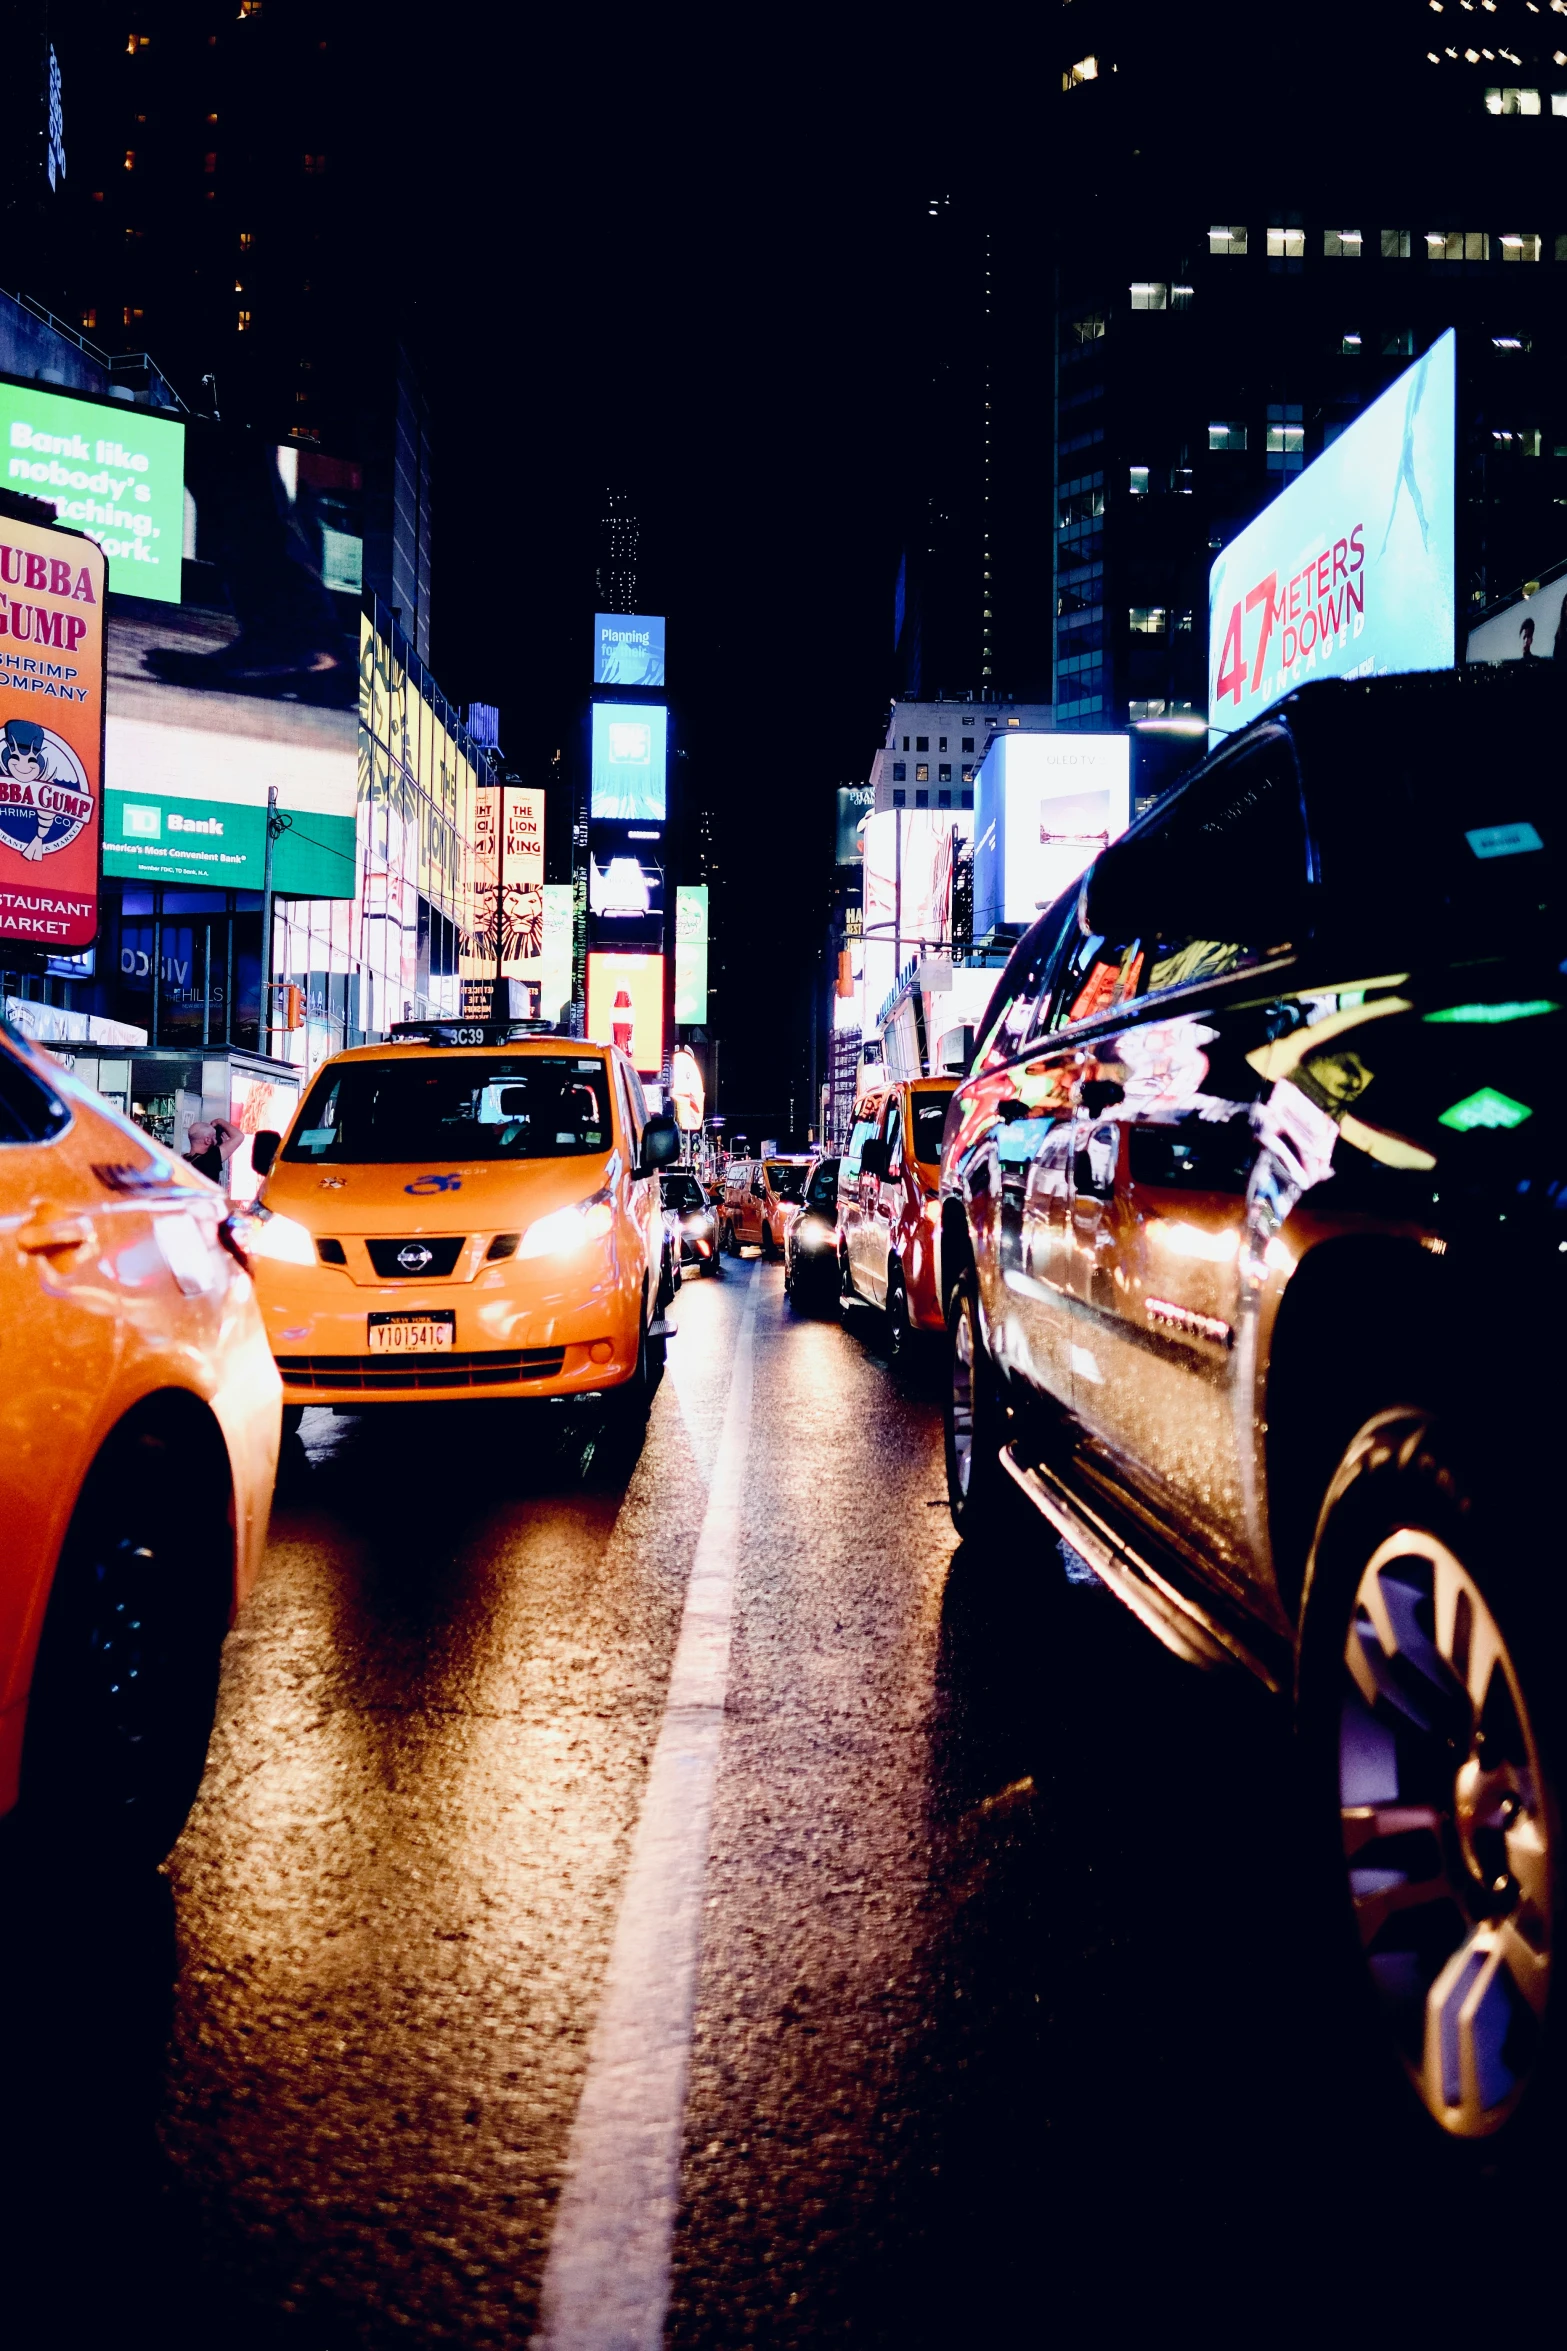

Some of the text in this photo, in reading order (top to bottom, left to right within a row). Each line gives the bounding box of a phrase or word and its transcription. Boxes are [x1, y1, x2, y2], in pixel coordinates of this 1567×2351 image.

[10, 422, 149, 473] Bank like
[8, 458, 151, 503] nobody's
[18, 492, 161, 539] tching,
[1216, 523, 1365, 706] 47 METERS
[1282, 569, 1364, 669] DOWN
[601, 629, 650, 646] Planning
[1262, 612, 1365, 702] UNCAGED
[38, 785, 91, 818] GUMP
[512, 805, 533, 816] THE
[127, 809, 224, 836] TD Bank
[509, 817, 537, 834] LION
[103, 841, 143, 853] America's
[144, 846, 167, 857] Most
[168, 848, 219, 862] Convenient
[507, 835, 541, 855] KING
[0, 915, 70, 935] ARKET
[450, 1028, 484, 1045] 3C39
[377, 1326, 444, 1347] Y101541C
